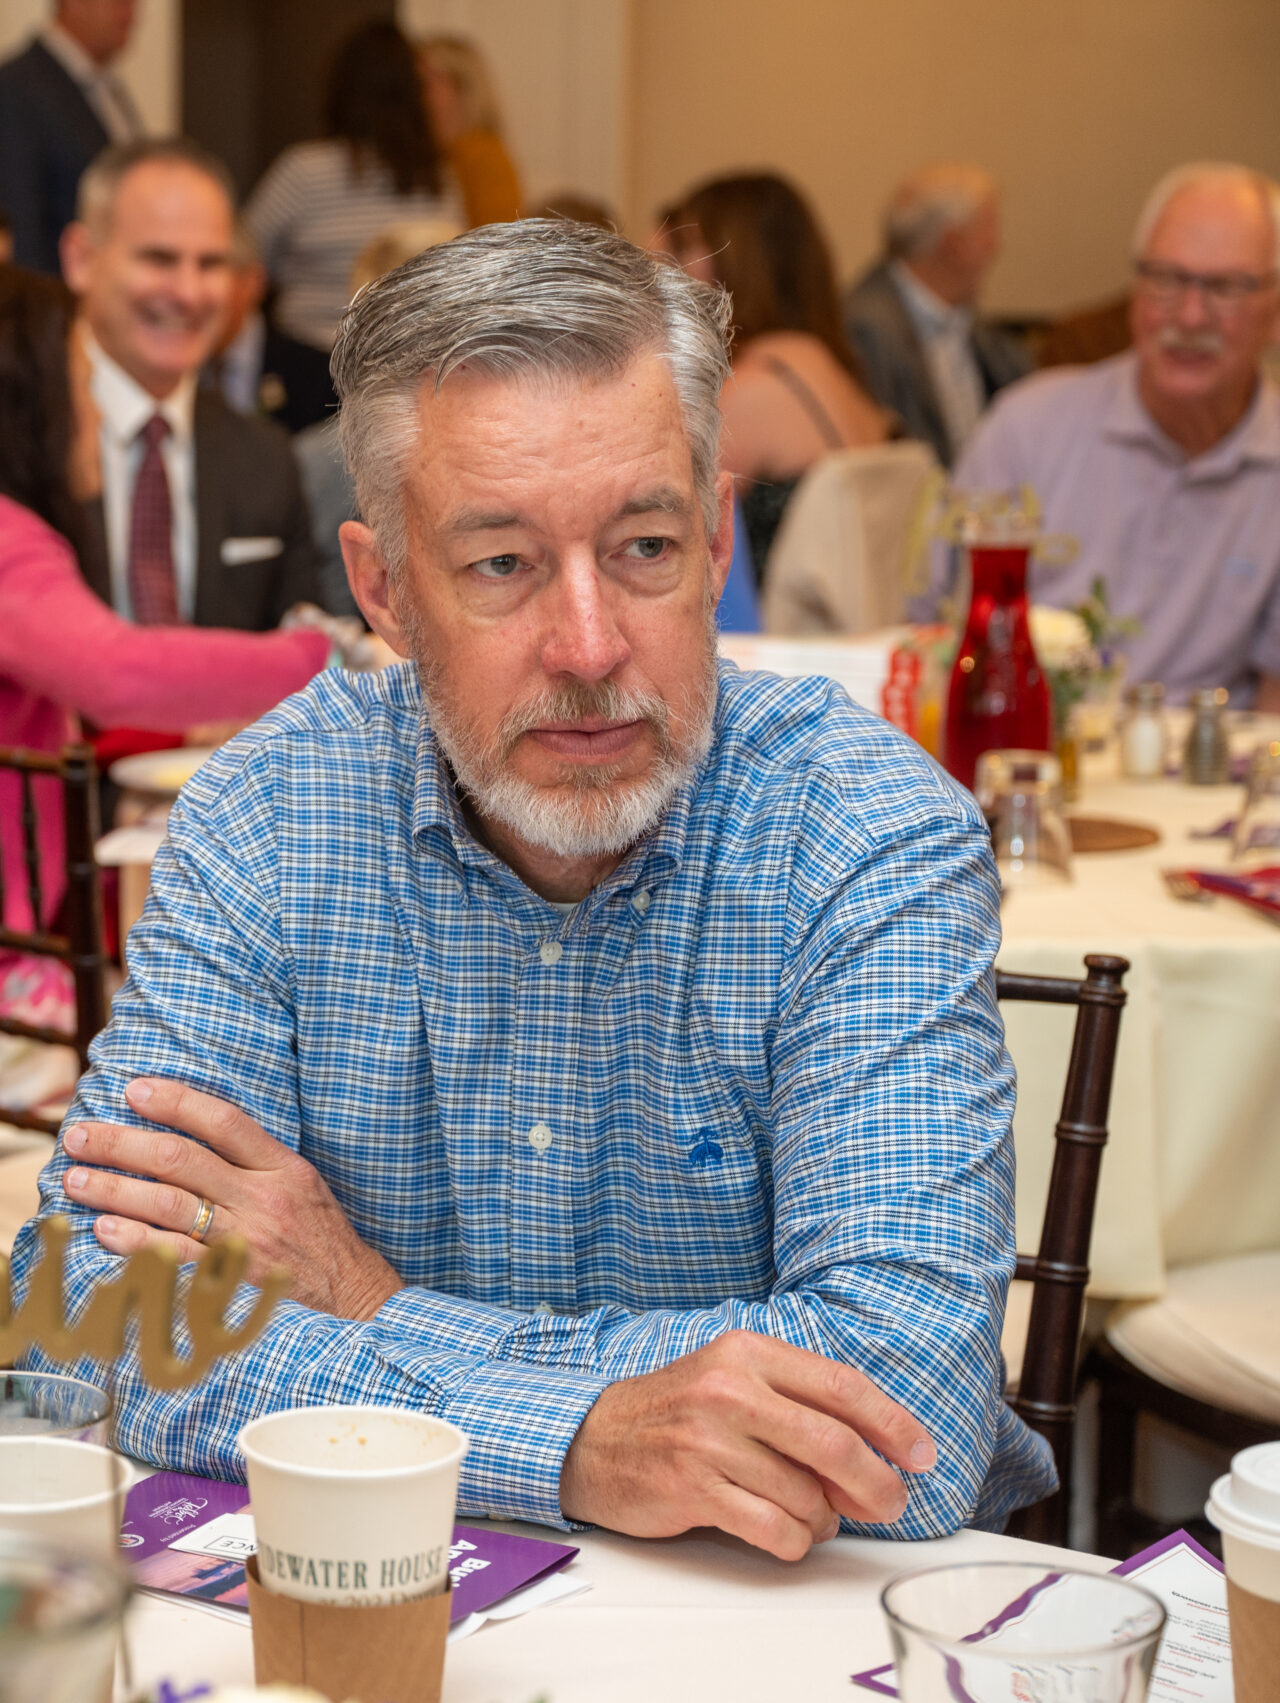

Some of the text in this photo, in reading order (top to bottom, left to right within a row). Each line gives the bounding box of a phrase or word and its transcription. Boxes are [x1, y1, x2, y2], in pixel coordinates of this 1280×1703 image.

[221, 1539, 256, 1551] NCE
[263, 1546, 445, 1590] DEWATER HOUSE
